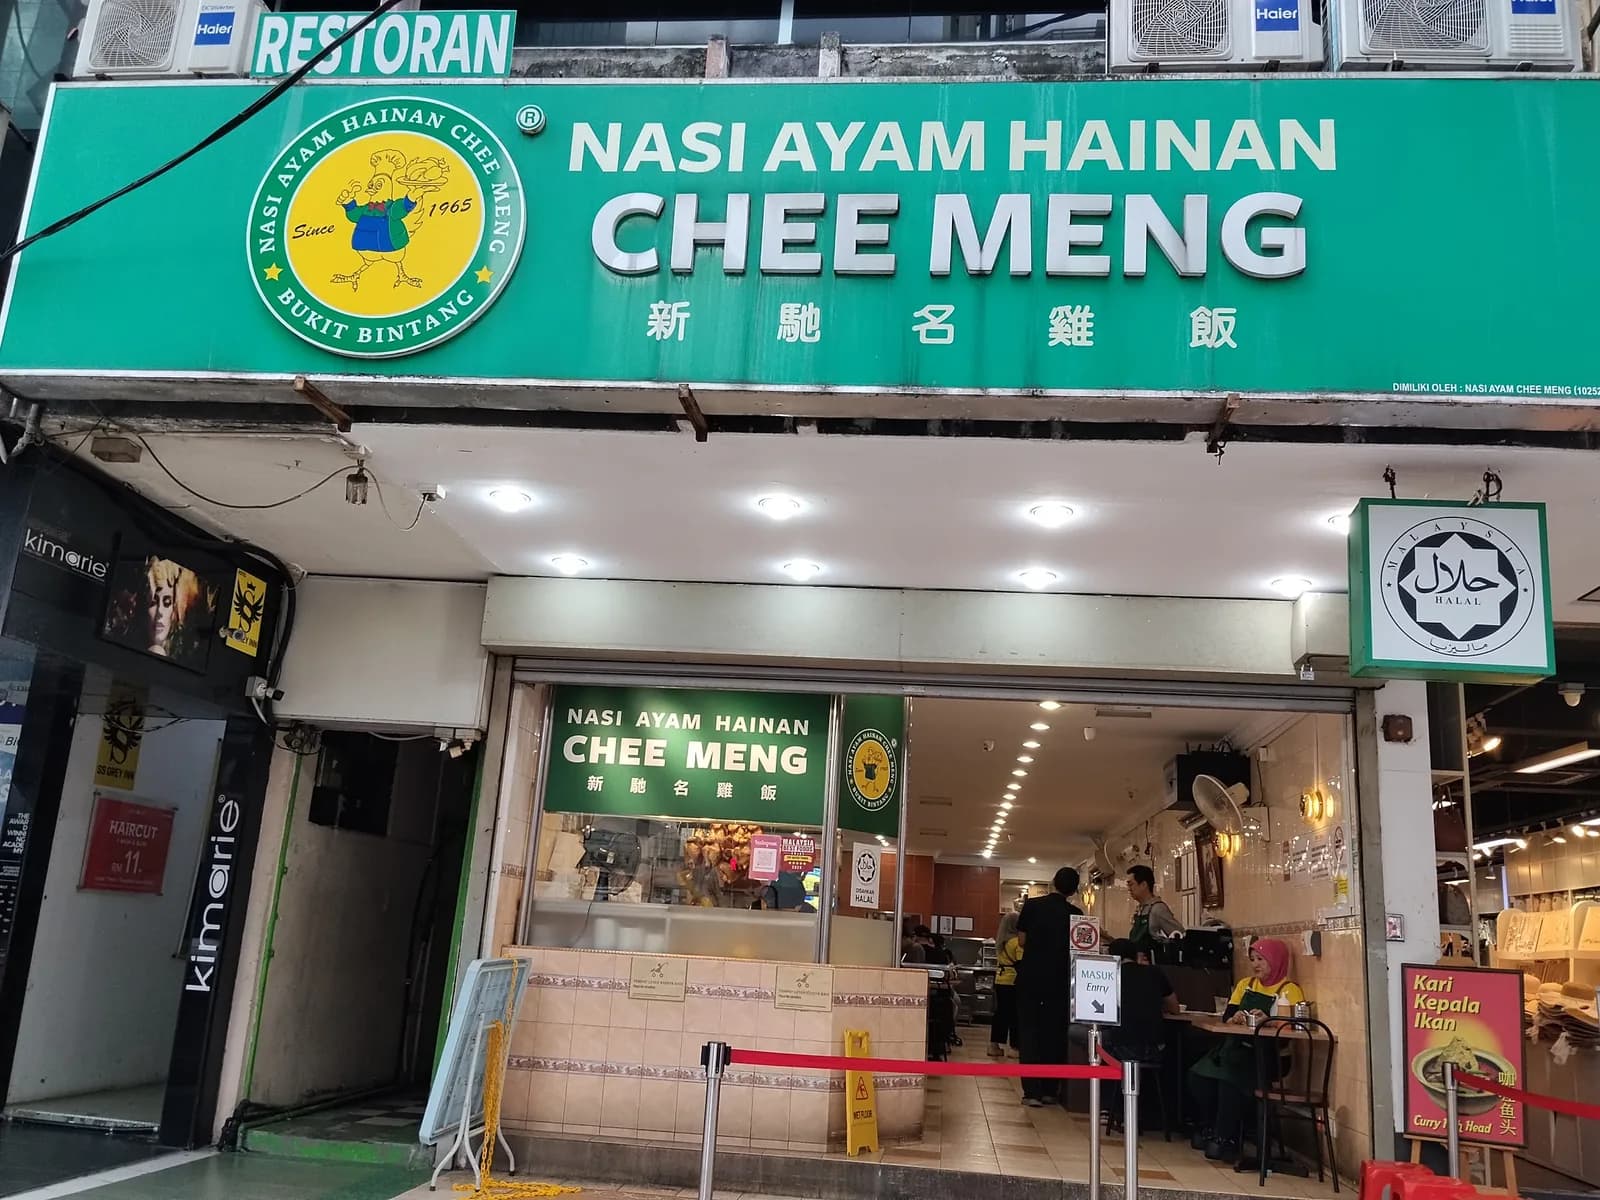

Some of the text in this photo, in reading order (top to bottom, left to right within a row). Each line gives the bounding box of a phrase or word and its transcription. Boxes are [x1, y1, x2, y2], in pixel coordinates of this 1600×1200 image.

[1256, 8, 1298, 19] Haier
[197, 24, 233, 35] Haier
[255, 14, 511, 75] RESTORAN
[569, 119, 1337, 173] NASI AYAM HAINAN
[259, 108, 511, 255] NASI AYAM HAINAN CHEE MENG
[429, 197, 474, 218] 1965
[291, 223, 336, 240] Since
[592, 191, 1307, 279] CHEE MENG
[277, 287, 475, 344] BUKIT BINTANG
[1392, 382, 1430, 392] DIMILIKI
[1431, 384, 1458, 393] OLEH
[1465, 384, 1488, 393] NASI
[1488, 384, 1514, 393] AYAM
[1516, 385, 1542, 394] CHEE
[1544, 385, 1571, 395] MENG
[25, 528, 106, 578] kimarie
[1387, 521, 1525, 576] MALAYSIA
[1414, 552, 1500, 594] حلال
[1435, 596, 1481, 606] HALAL
[567, 708, 809, 736] NASI AYAM HAINAN
[563, 735, 808, 775] CHEE MENG
[109, 820, 159, 840] HAIRCUT
[782, 838, 814, 846] MALAYSIA
[185, 799, 240, 992] kimarie
[855, 894, 874, 904] HALAL
[1081, 969, 1114, 981] MASUK
[1413, 974, 1454, 993] Kari
[1086, 982, 1109, 995] Entry
[1413, 993, 1481, 1015] Kepala
[1414, 1013, 1457, 1032] Ikan
[1413, 1114, 1442, 1130] Curry
[1465, 1120, 1493, 1134] Head
